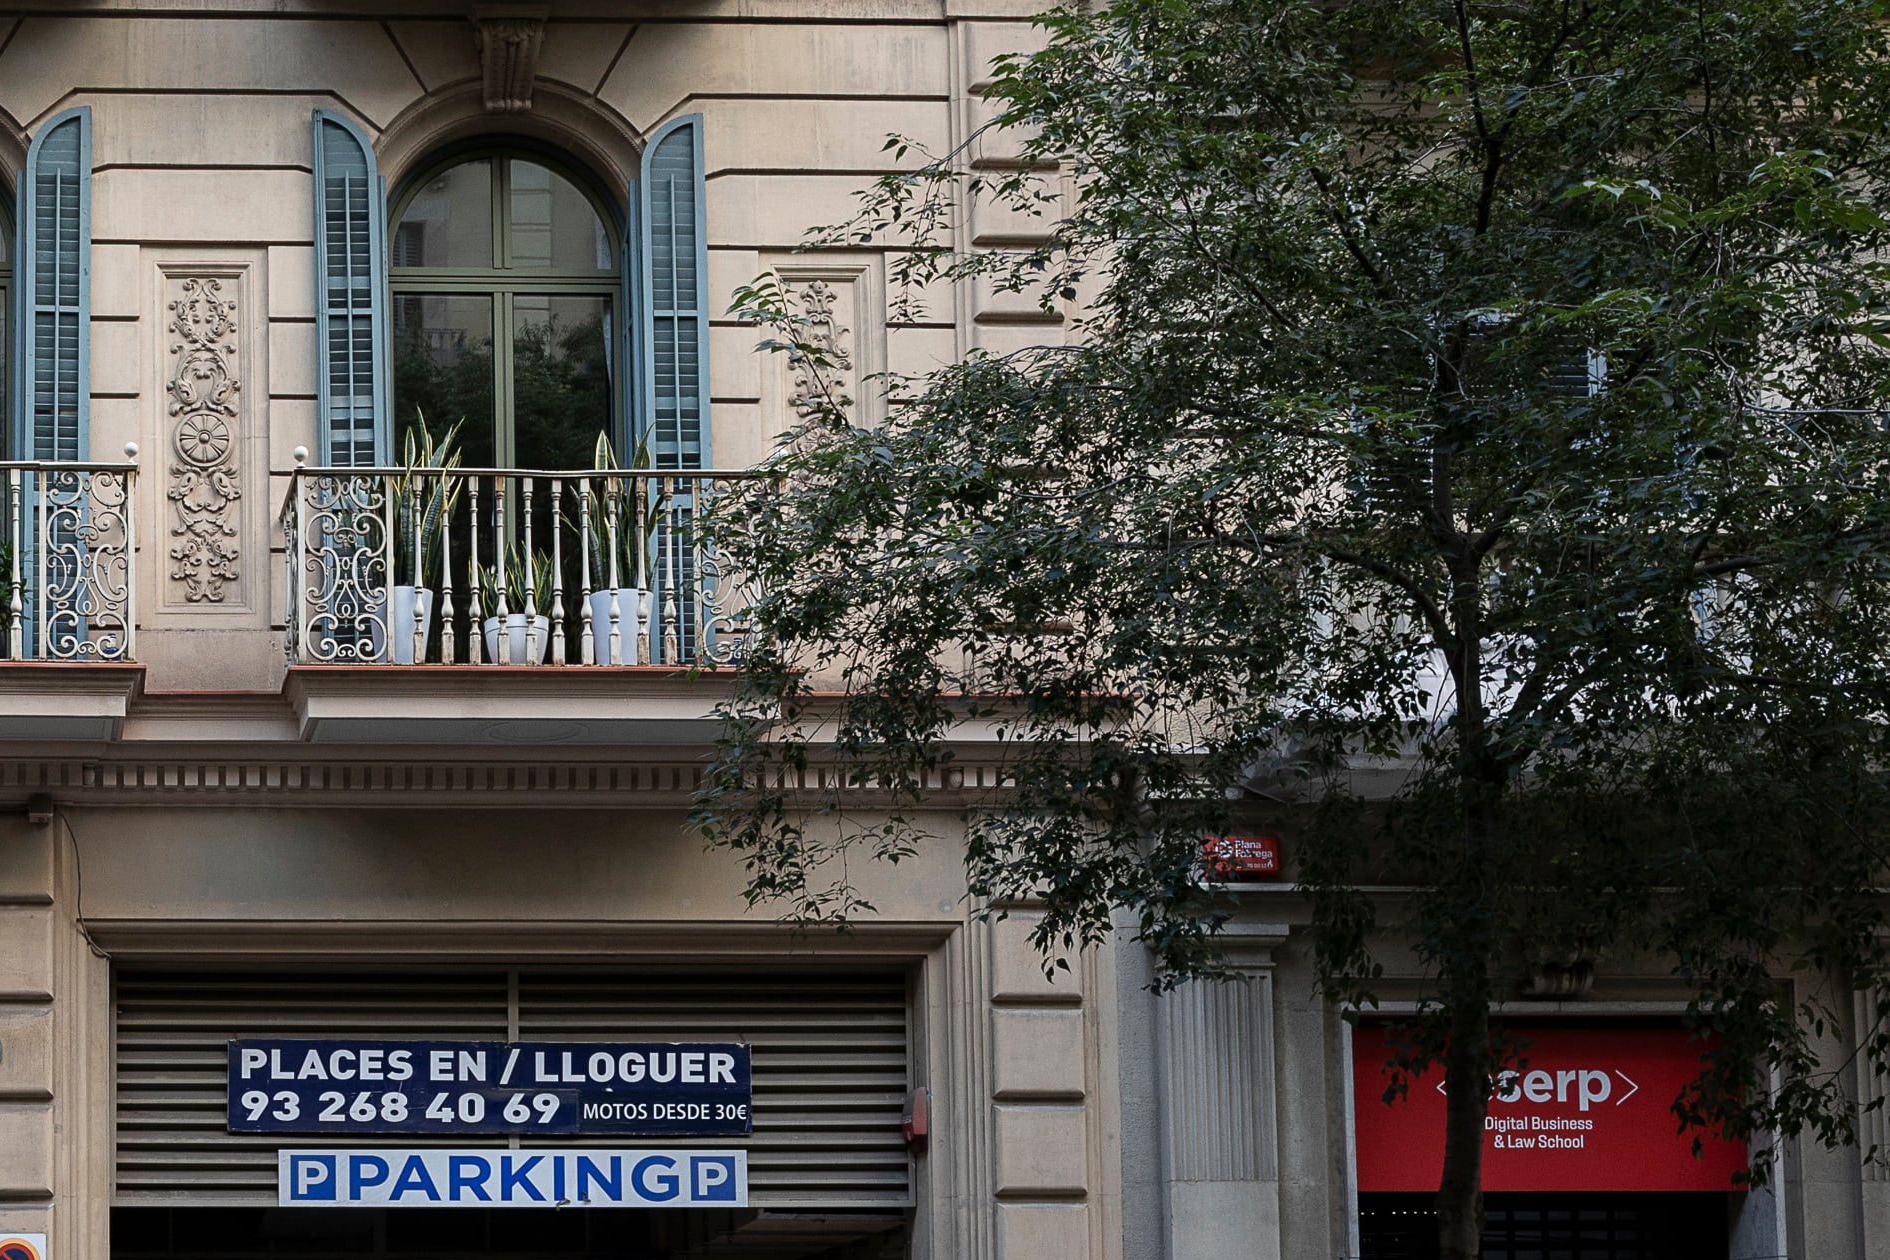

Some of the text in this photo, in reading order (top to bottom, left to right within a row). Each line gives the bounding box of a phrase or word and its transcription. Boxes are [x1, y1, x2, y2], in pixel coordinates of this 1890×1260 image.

[1235, 840, 1262, 849] Plana
[241, 1048, 413, 1081] PLACES
[429, 1050, 486, 1082] EN
[535, 1051, 736, 1084] LLOGUER
[242, 1090, 748, 1124] 93 268 40 69 MOTOS DESDE 30€
[1488, 1069, 1612, 1112] serp
[1484, 1115, 1594, 1133] Digital Business
[1493, 1134, 1585, 1149] & Law School
[348, 1154, 680, 1202] PARKING
